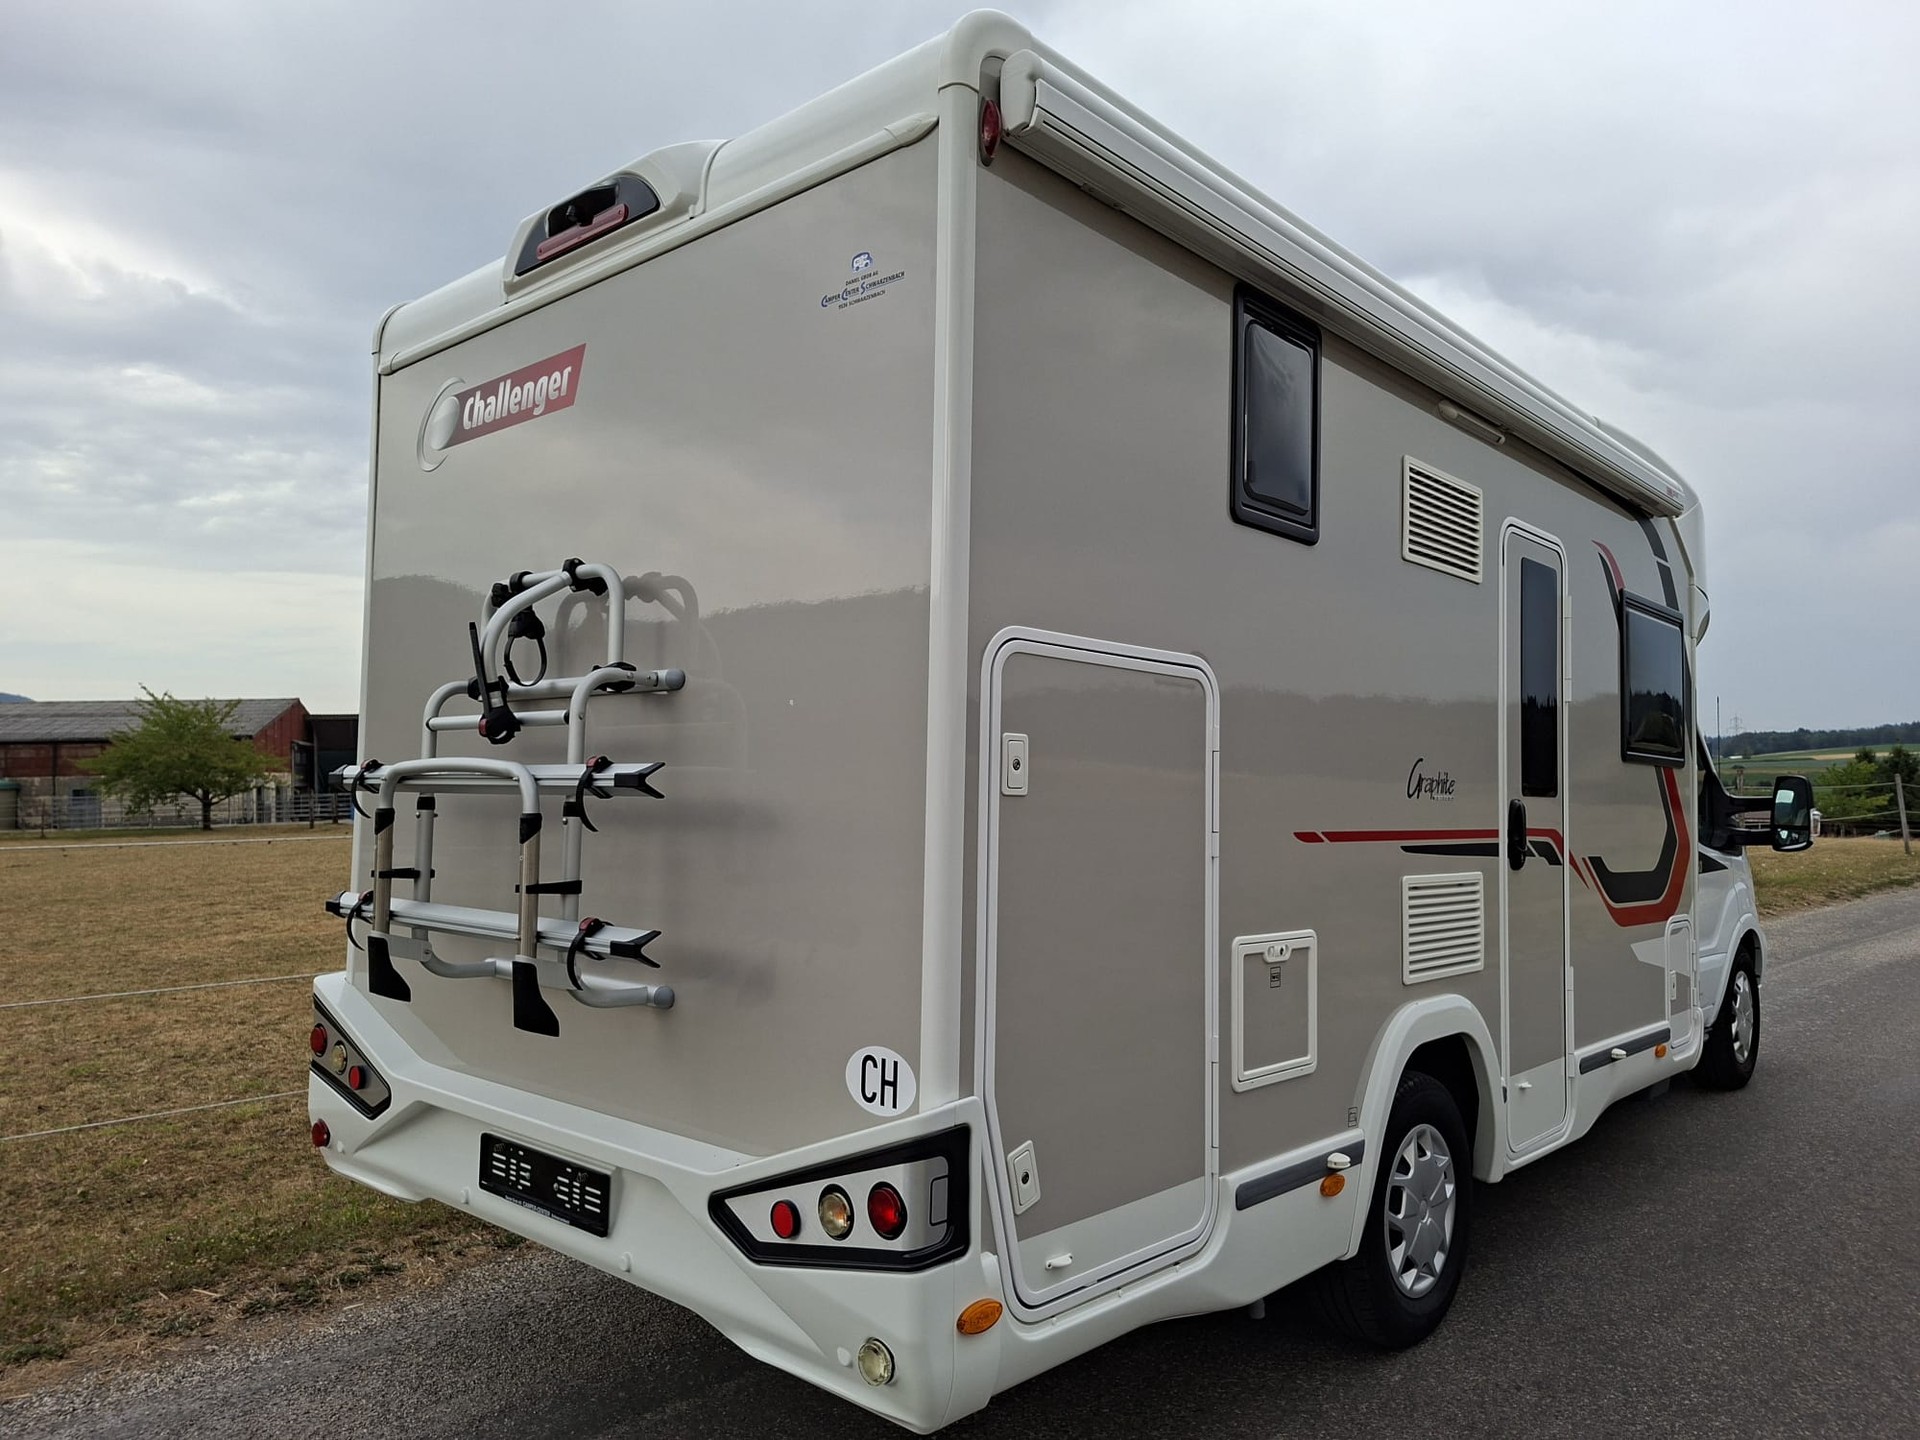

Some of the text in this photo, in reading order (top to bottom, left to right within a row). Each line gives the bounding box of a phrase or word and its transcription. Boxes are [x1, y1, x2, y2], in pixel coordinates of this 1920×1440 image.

[821, 293, 841, 308] CAMPER
[841, 287, 860, 301] CENTER
[860, 271, 905, 295] SCHWARZENBACH
[463, 366, 572, 430] Challenger
[1407, 758, 1456, 800] Graphite
[861, 1054, 898, 1110] CH
